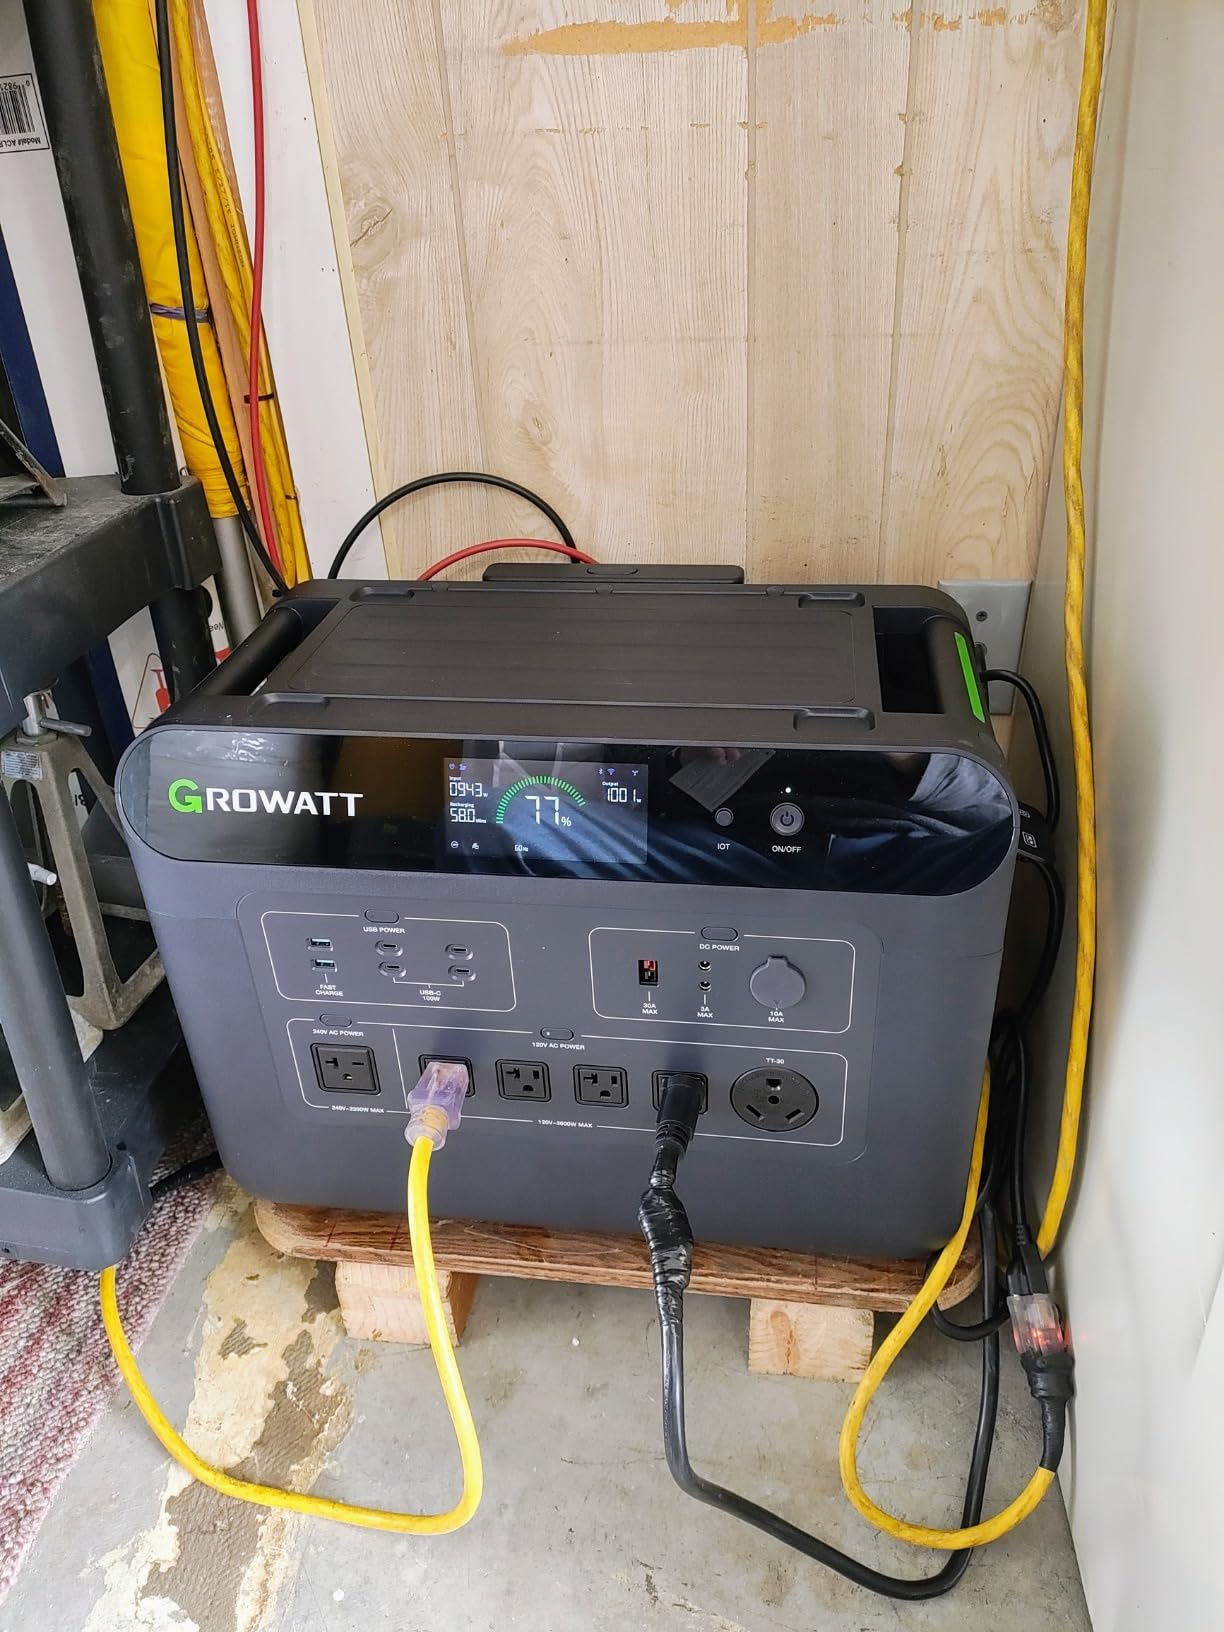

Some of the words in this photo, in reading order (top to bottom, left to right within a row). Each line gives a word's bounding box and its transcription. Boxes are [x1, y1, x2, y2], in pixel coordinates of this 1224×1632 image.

[168, 779, 364, 817] GROWATT
[717, 843, 731, 851] IOT
[771, 845, 802, 853] ON/OFF
[315, 989, 344, 997] CHARGE
[766, 1057, 785, 1065] TT-30
[578, 1121, 593, 1129] MAX
